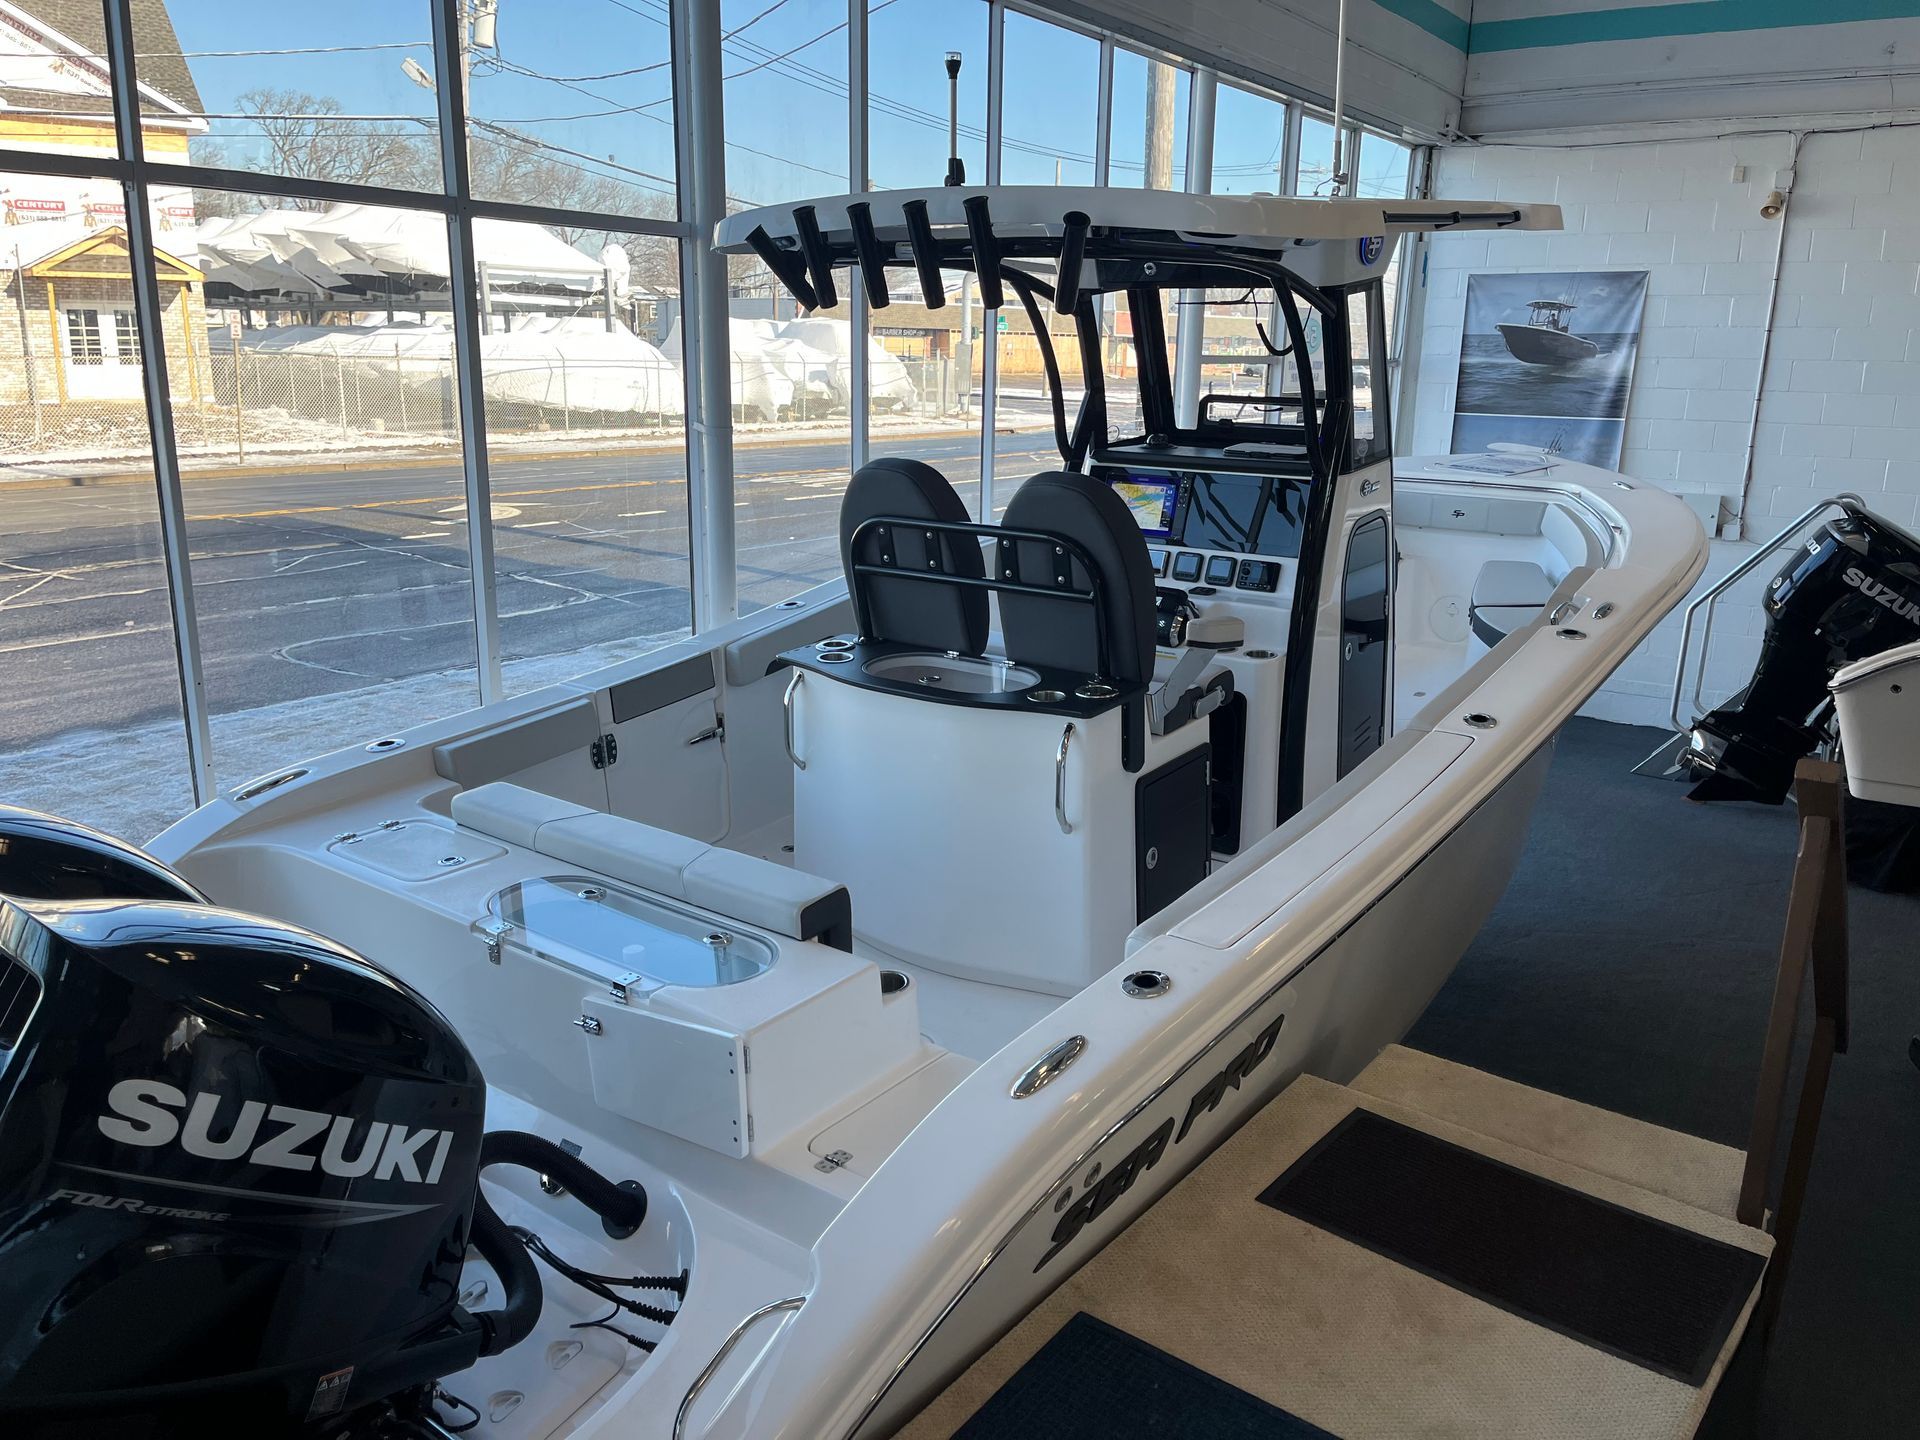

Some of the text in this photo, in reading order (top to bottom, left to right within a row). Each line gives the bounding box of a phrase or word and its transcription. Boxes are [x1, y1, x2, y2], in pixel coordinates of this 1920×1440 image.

[16, 201, 64, 209] CENTURY
[882, 328, 902, 336] BARBER
[1842, 567, 1920, 626] SUZUK
[97, 1078, 455, 1185] SUZUKI
